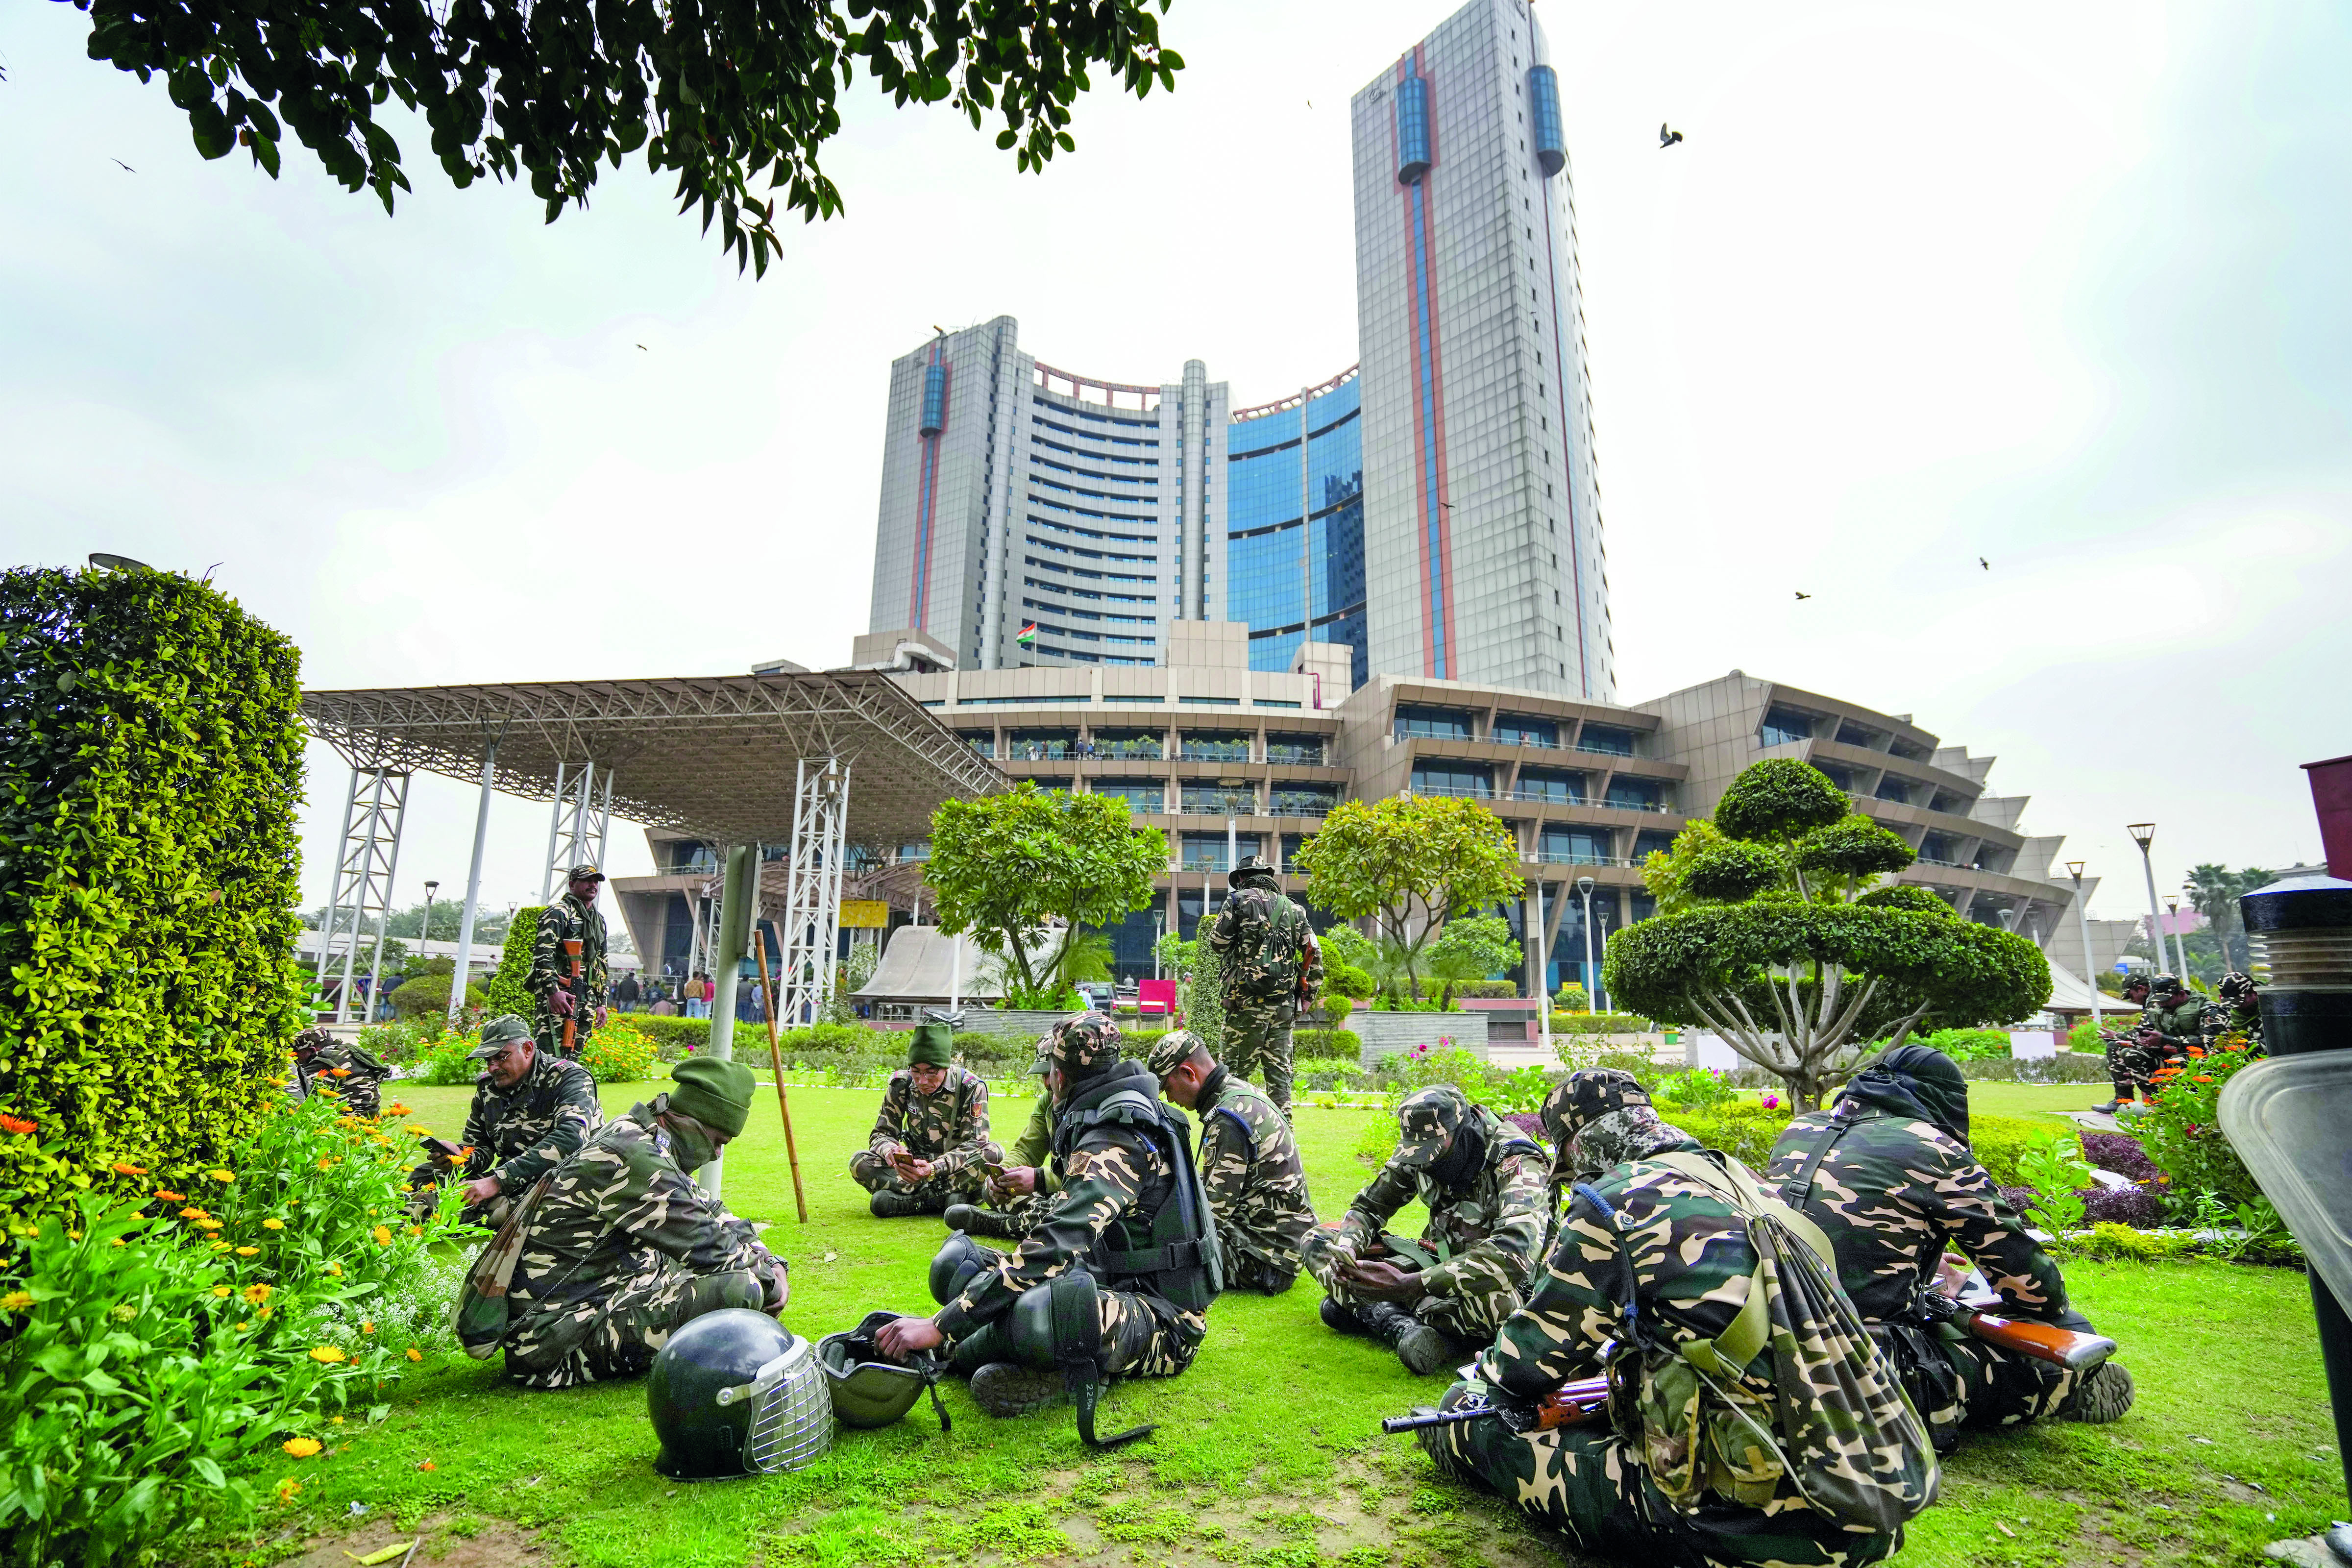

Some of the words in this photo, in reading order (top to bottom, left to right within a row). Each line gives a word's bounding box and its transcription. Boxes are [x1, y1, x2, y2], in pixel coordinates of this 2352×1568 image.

[967, 1079, 978, 1088] SSB
[658, 1134, 670, 1147] SSB
[1086, 1384, 1093, 1398] 22
